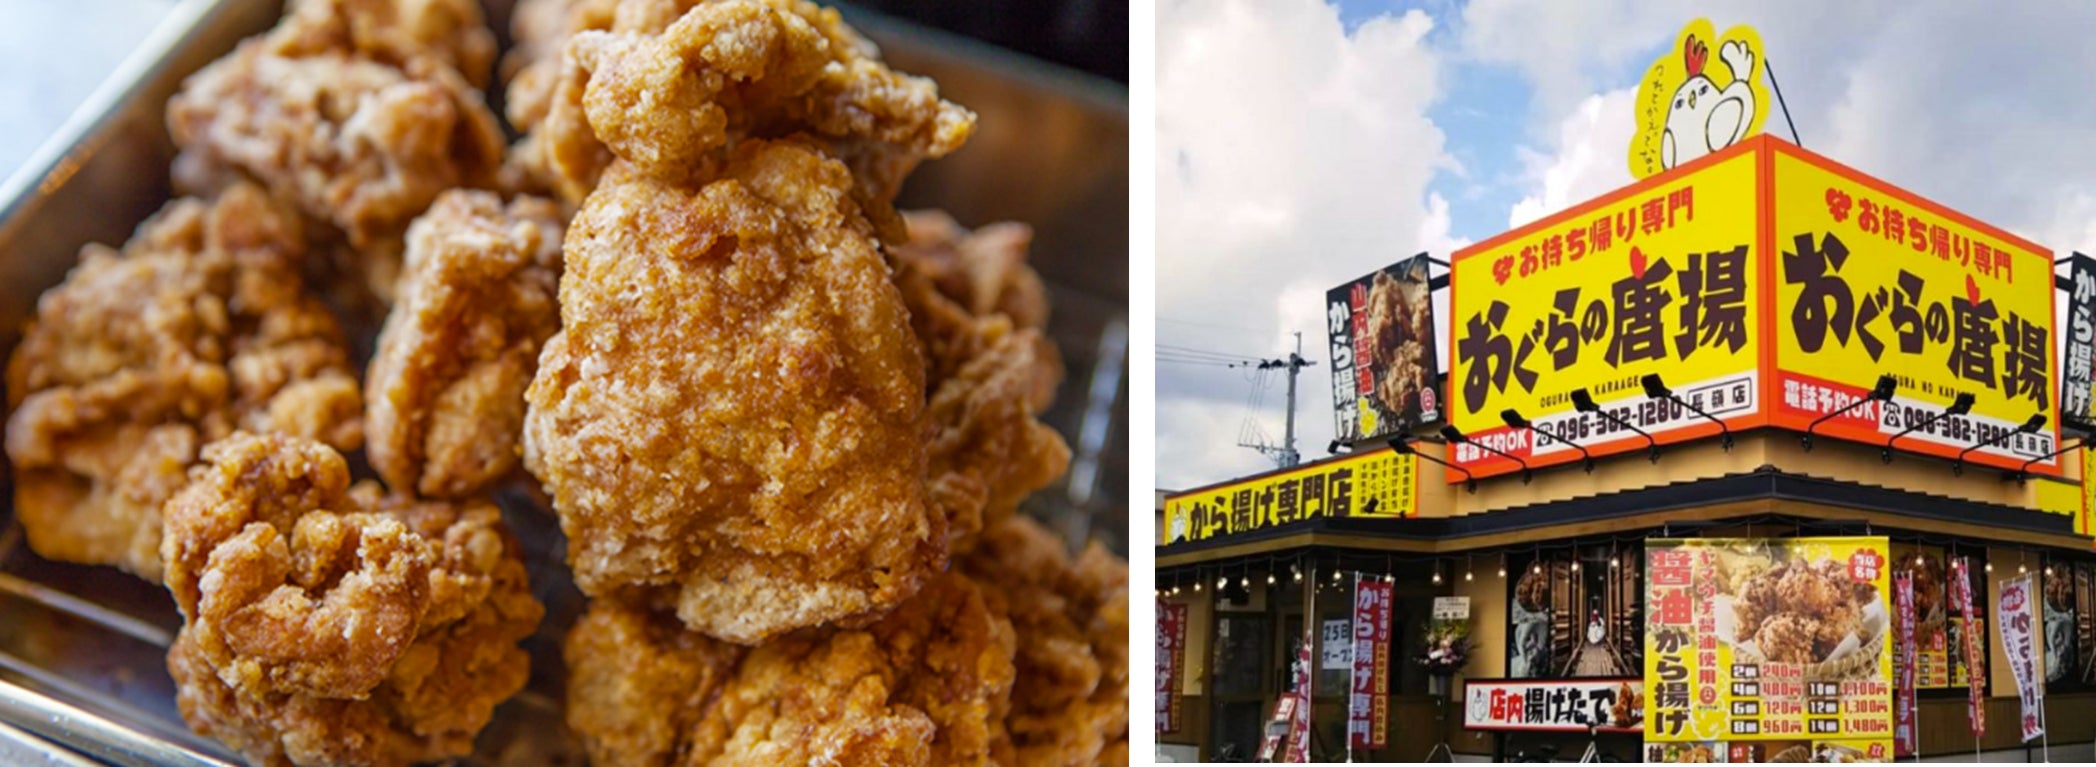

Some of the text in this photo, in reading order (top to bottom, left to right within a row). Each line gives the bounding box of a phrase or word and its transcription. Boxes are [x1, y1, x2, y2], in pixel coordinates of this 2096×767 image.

[1519, 186, 1693, 279] お持ち帰り専門
[1858, 197, 2012, 284] お持ち帰り専門
[1458, 245, 1750, 414] おぐらの唐揚
[1782, 231, 2048, 412] おぐらの唐揚
[1329, 301, 1357, 439] から揚げ
[1594, 376, 1639, 395] KARAAGE
[1784, 379, 1876, 420] 電話予約OK
[1557, 395, 1682, 442] 096-382-1280
[1904, 406, 2010, 449] 096-382-1280
[1190, 468, 1353, 539] から揚げ専門店
[1651, 550, 1692, 736] 醤油から揚げ
[1488, 686, 1616, 725] 店内揚げたて
